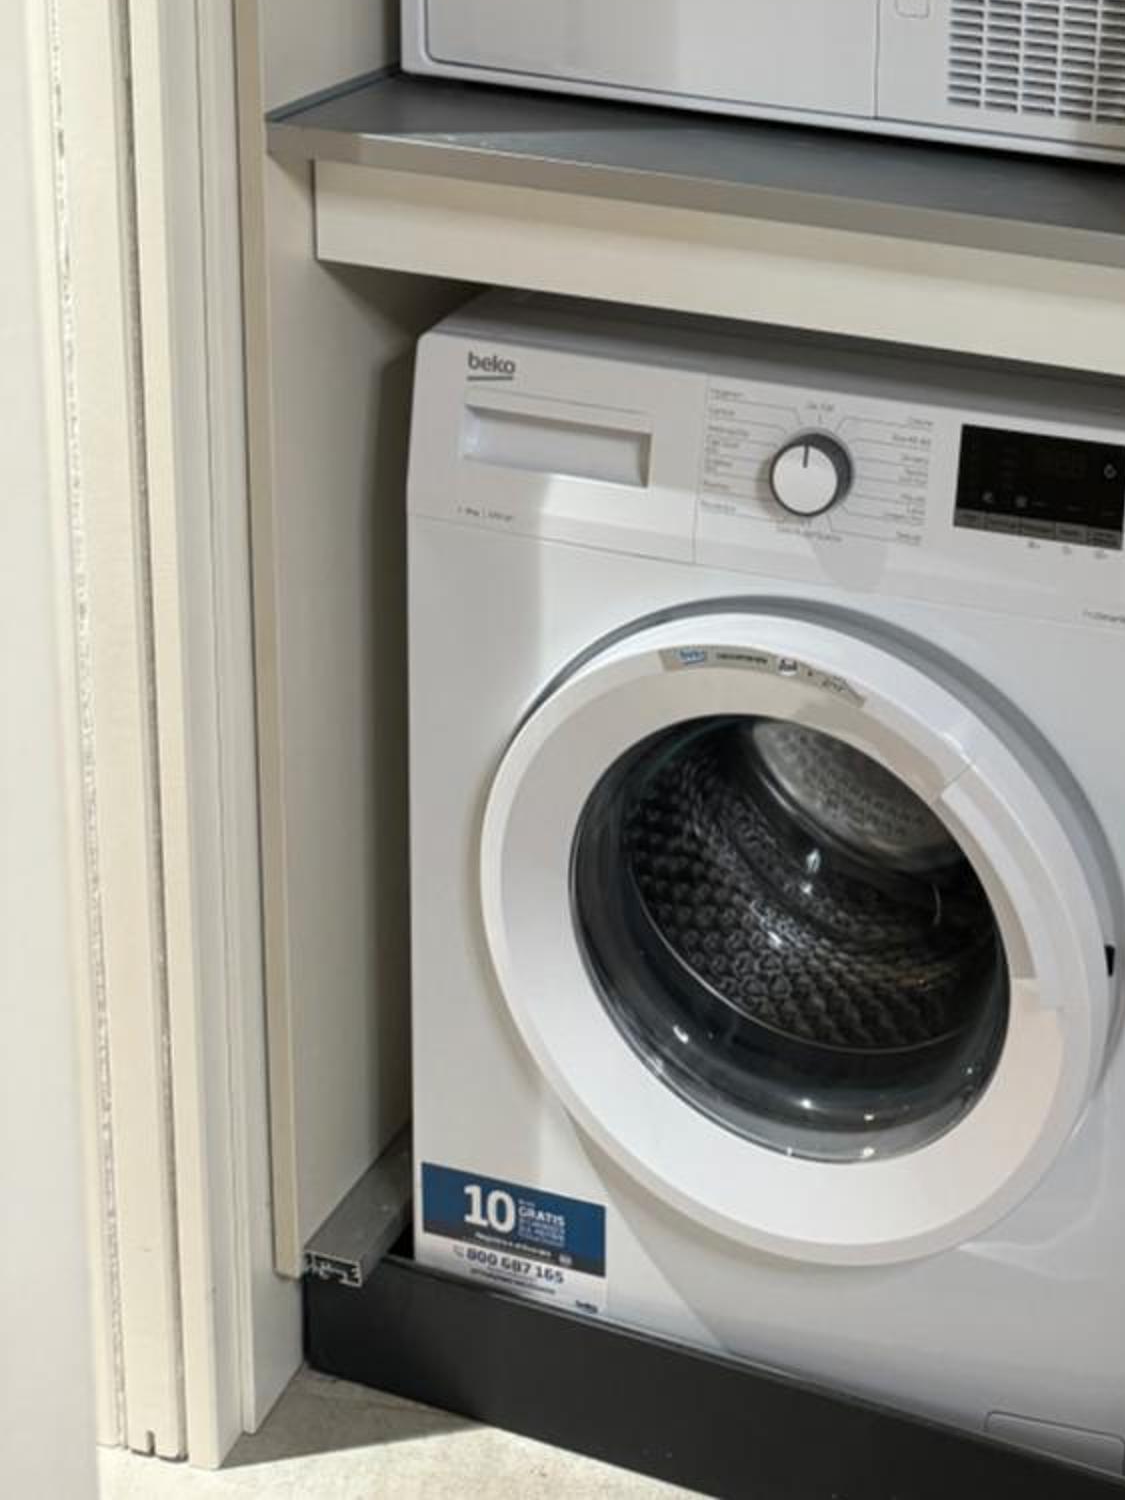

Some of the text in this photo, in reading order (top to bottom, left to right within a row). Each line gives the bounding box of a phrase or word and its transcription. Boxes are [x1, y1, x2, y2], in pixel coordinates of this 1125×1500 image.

[467, 351, 516, 374] beko
[464, 1185, 516, 1234] 10
[518, 1205, 566, 1227] GRATIS
[466, 1247, 498, 1267] 800
[500, 1257, 532, 1275] 687
[535, 1266, 565, 1285] 165
